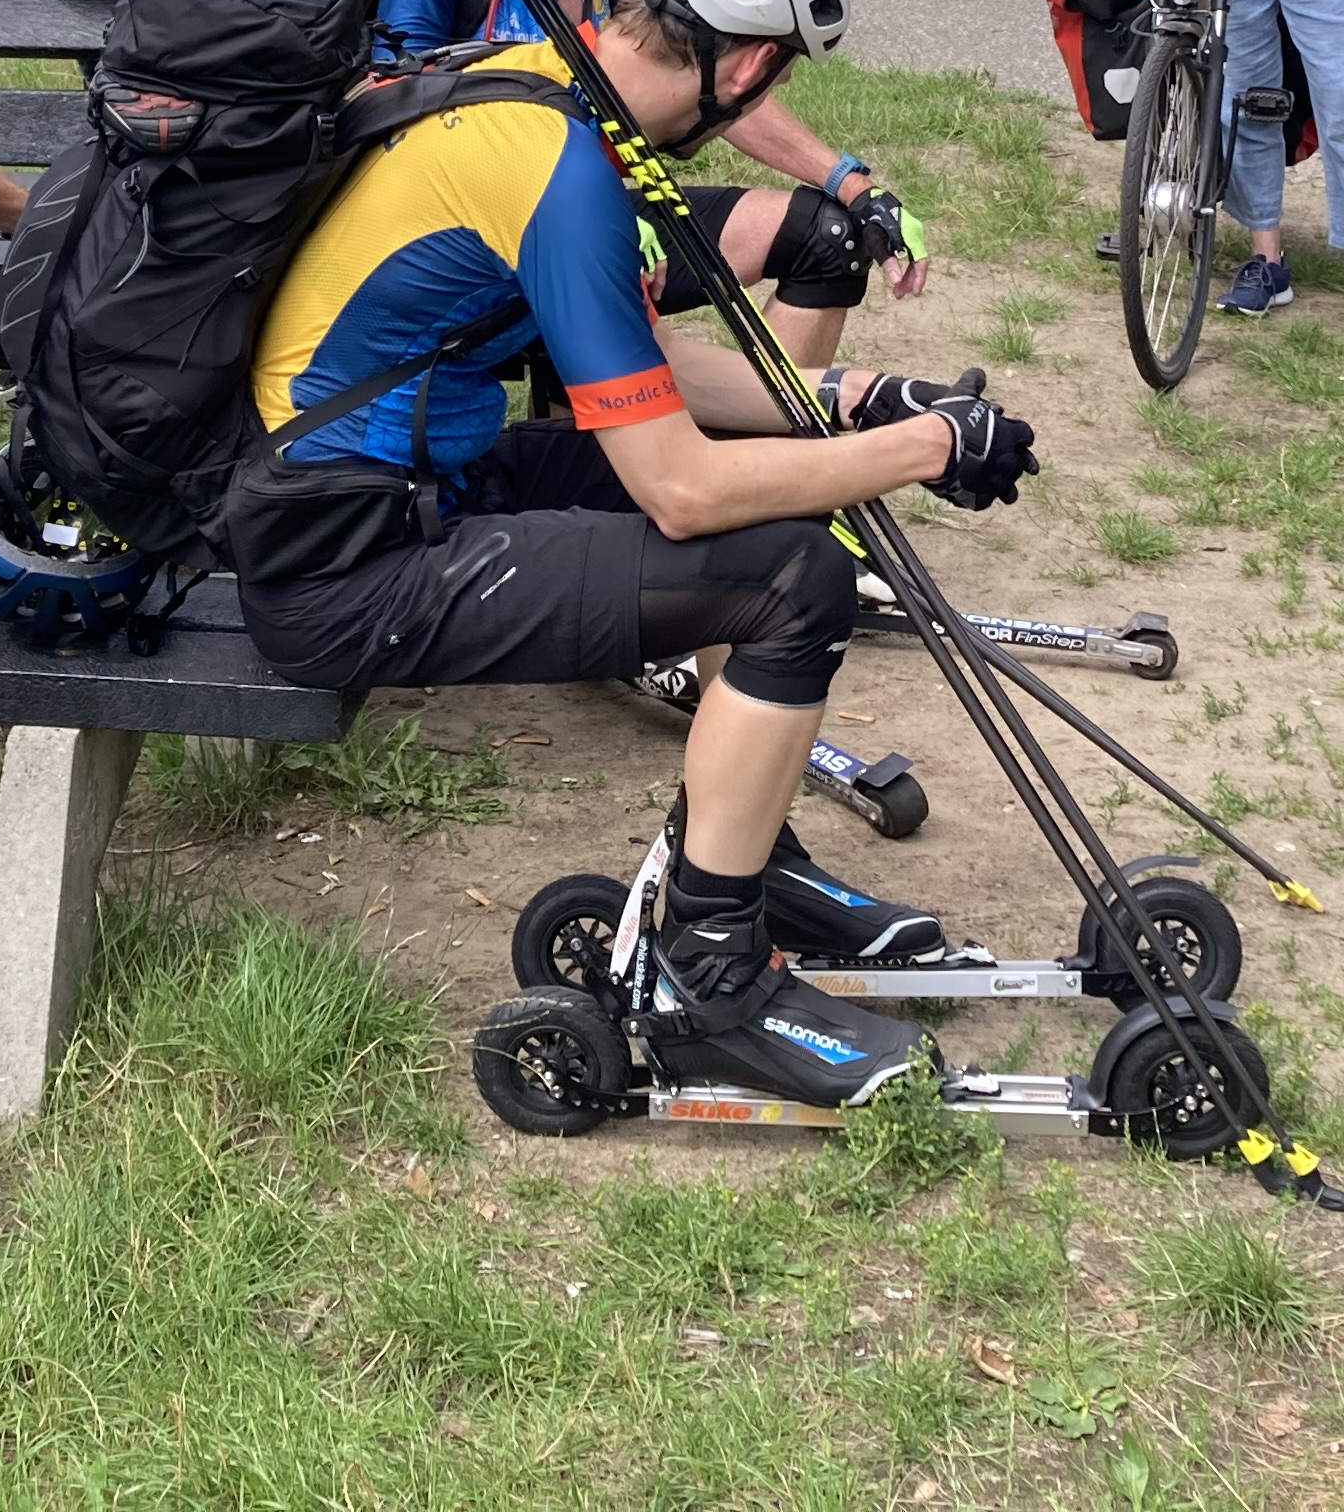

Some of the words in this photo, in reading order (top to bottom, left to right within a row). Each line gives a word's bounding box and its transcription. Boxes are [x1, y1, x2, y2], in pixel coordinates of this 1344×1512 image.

[600, 120, 665, 202] LEKI
[597, 386, 661, 409] Nordic
[1015, 631, 1086, 650] FinStep
[763, 1017, 842, 1054] salomon
[669, 1090, 753, 1121] skike
